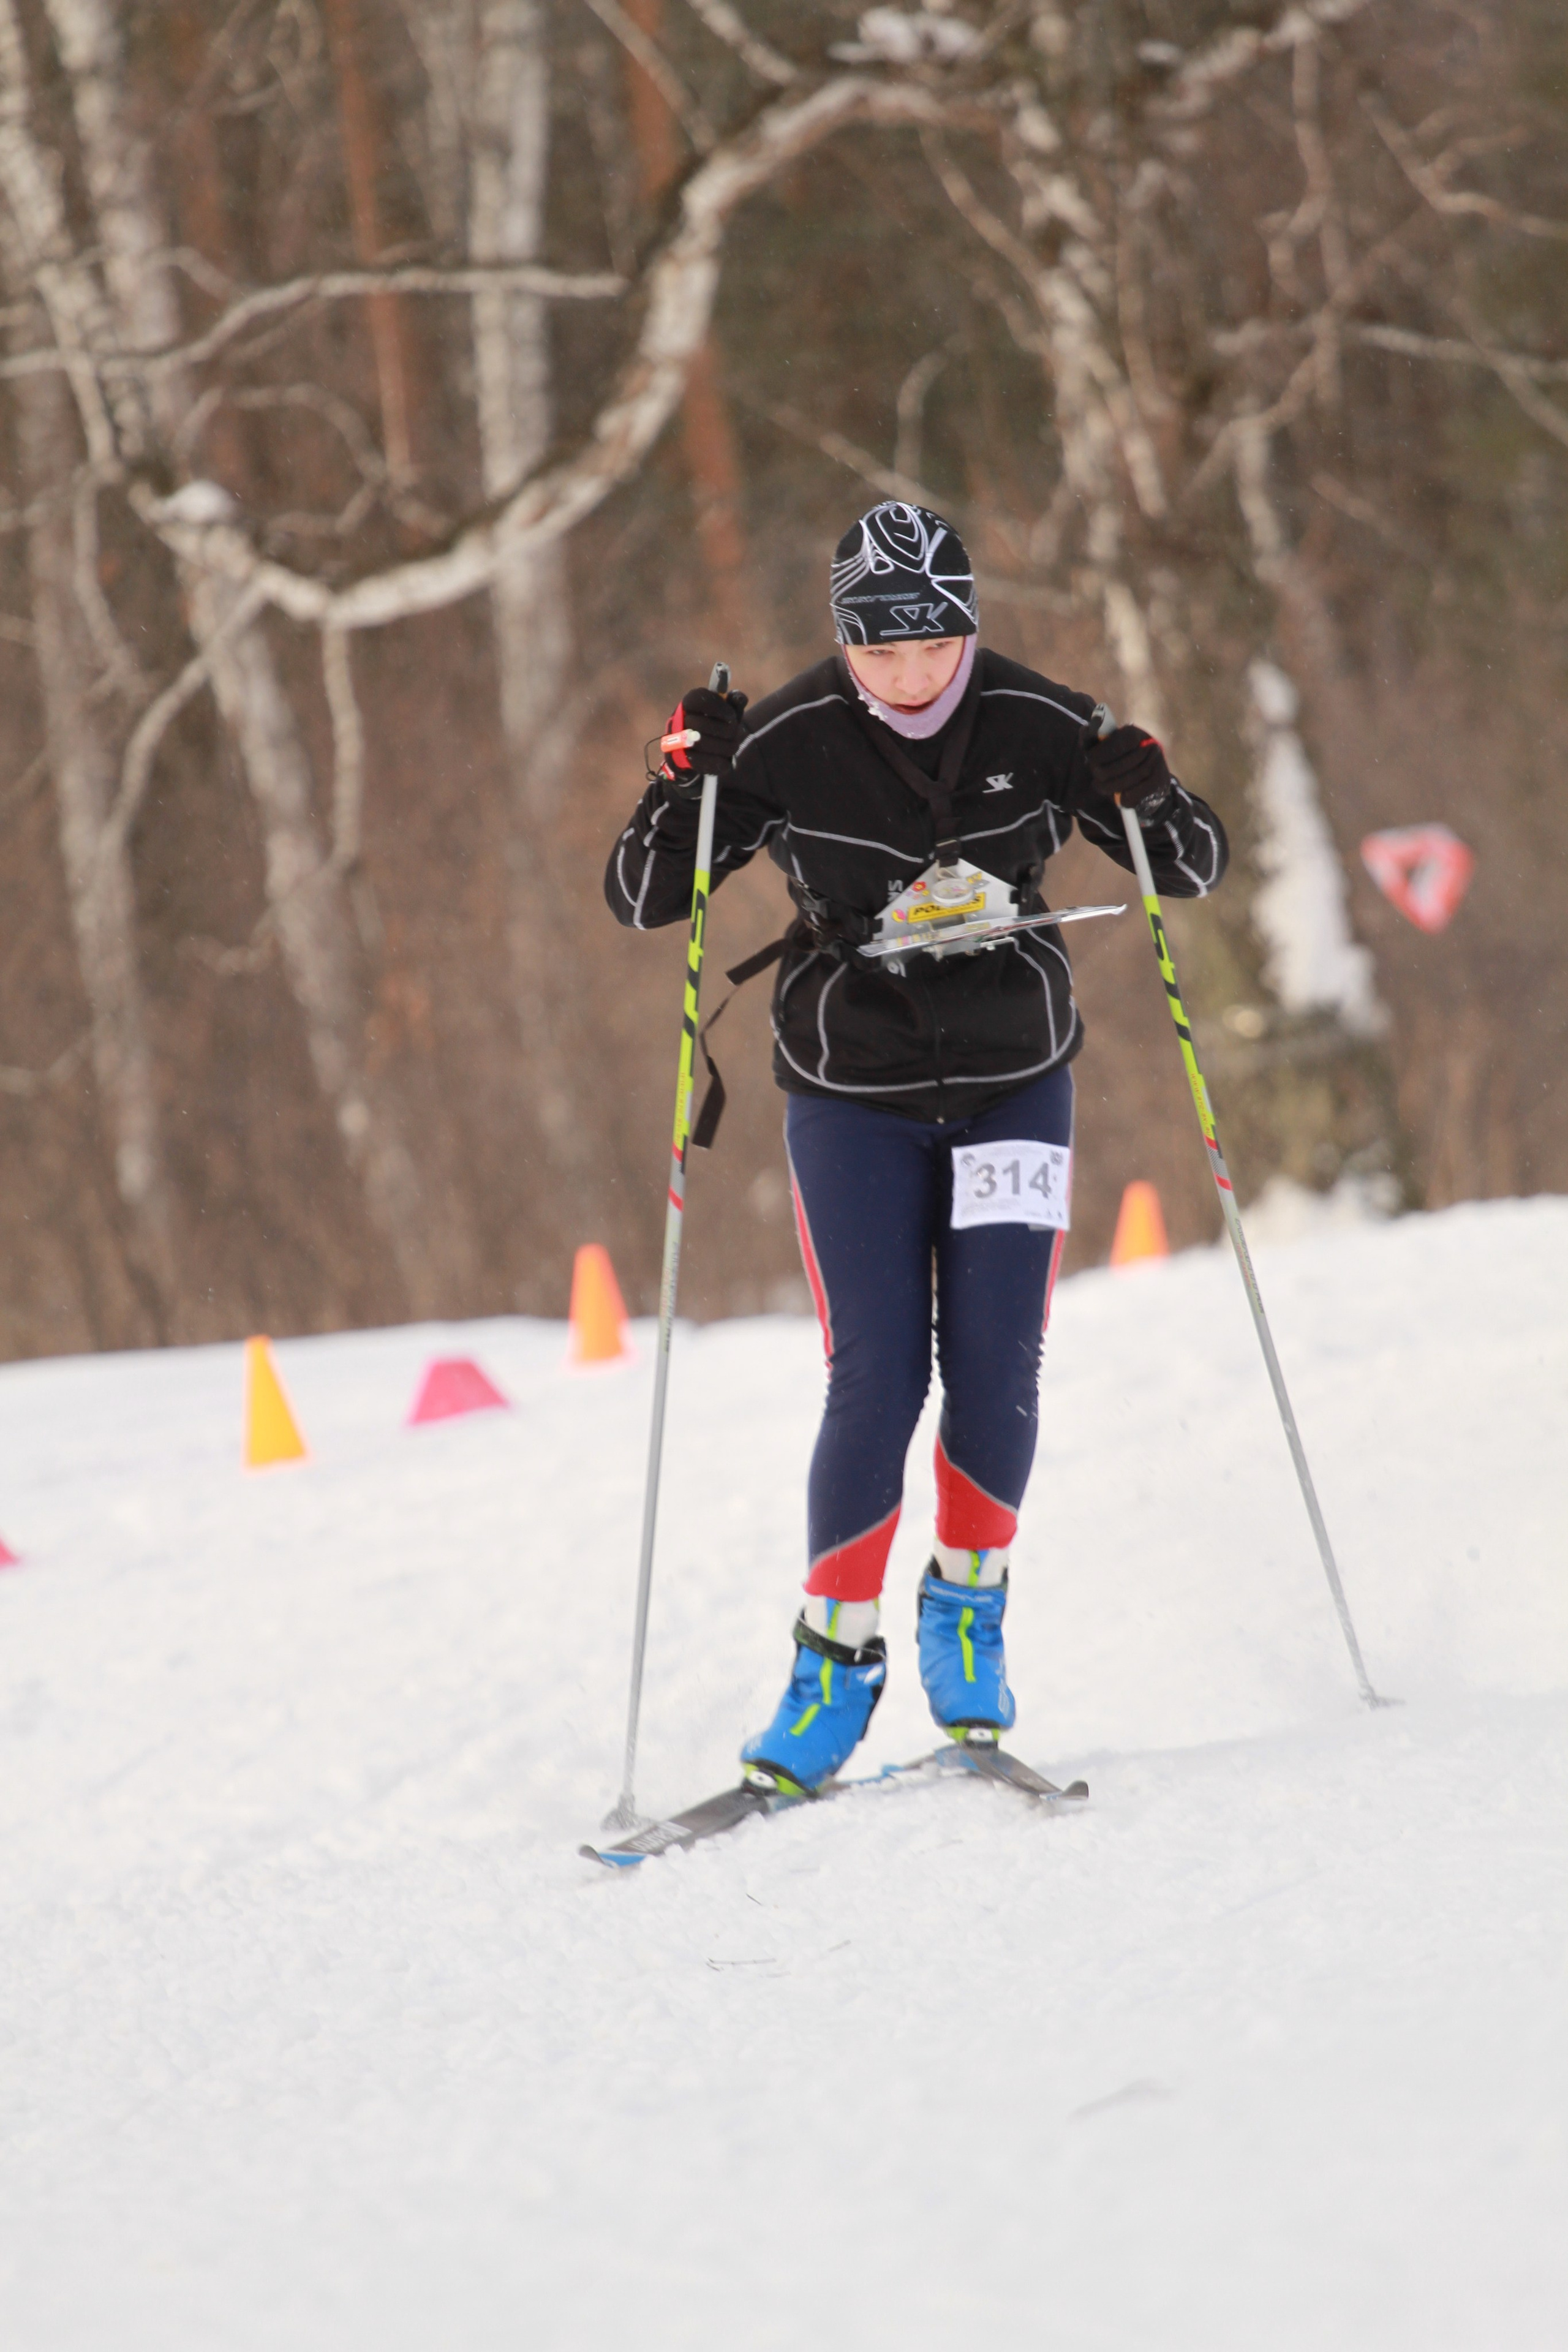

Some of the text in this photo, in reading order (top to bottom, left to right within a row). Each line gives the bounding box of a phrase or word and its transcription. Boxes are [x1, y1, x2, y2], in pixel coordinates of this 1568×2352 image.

[880, 602, 948, 636] SK
[982, 772, 1014, 793] SK
[974, 1160, 1052, 1199] 314
